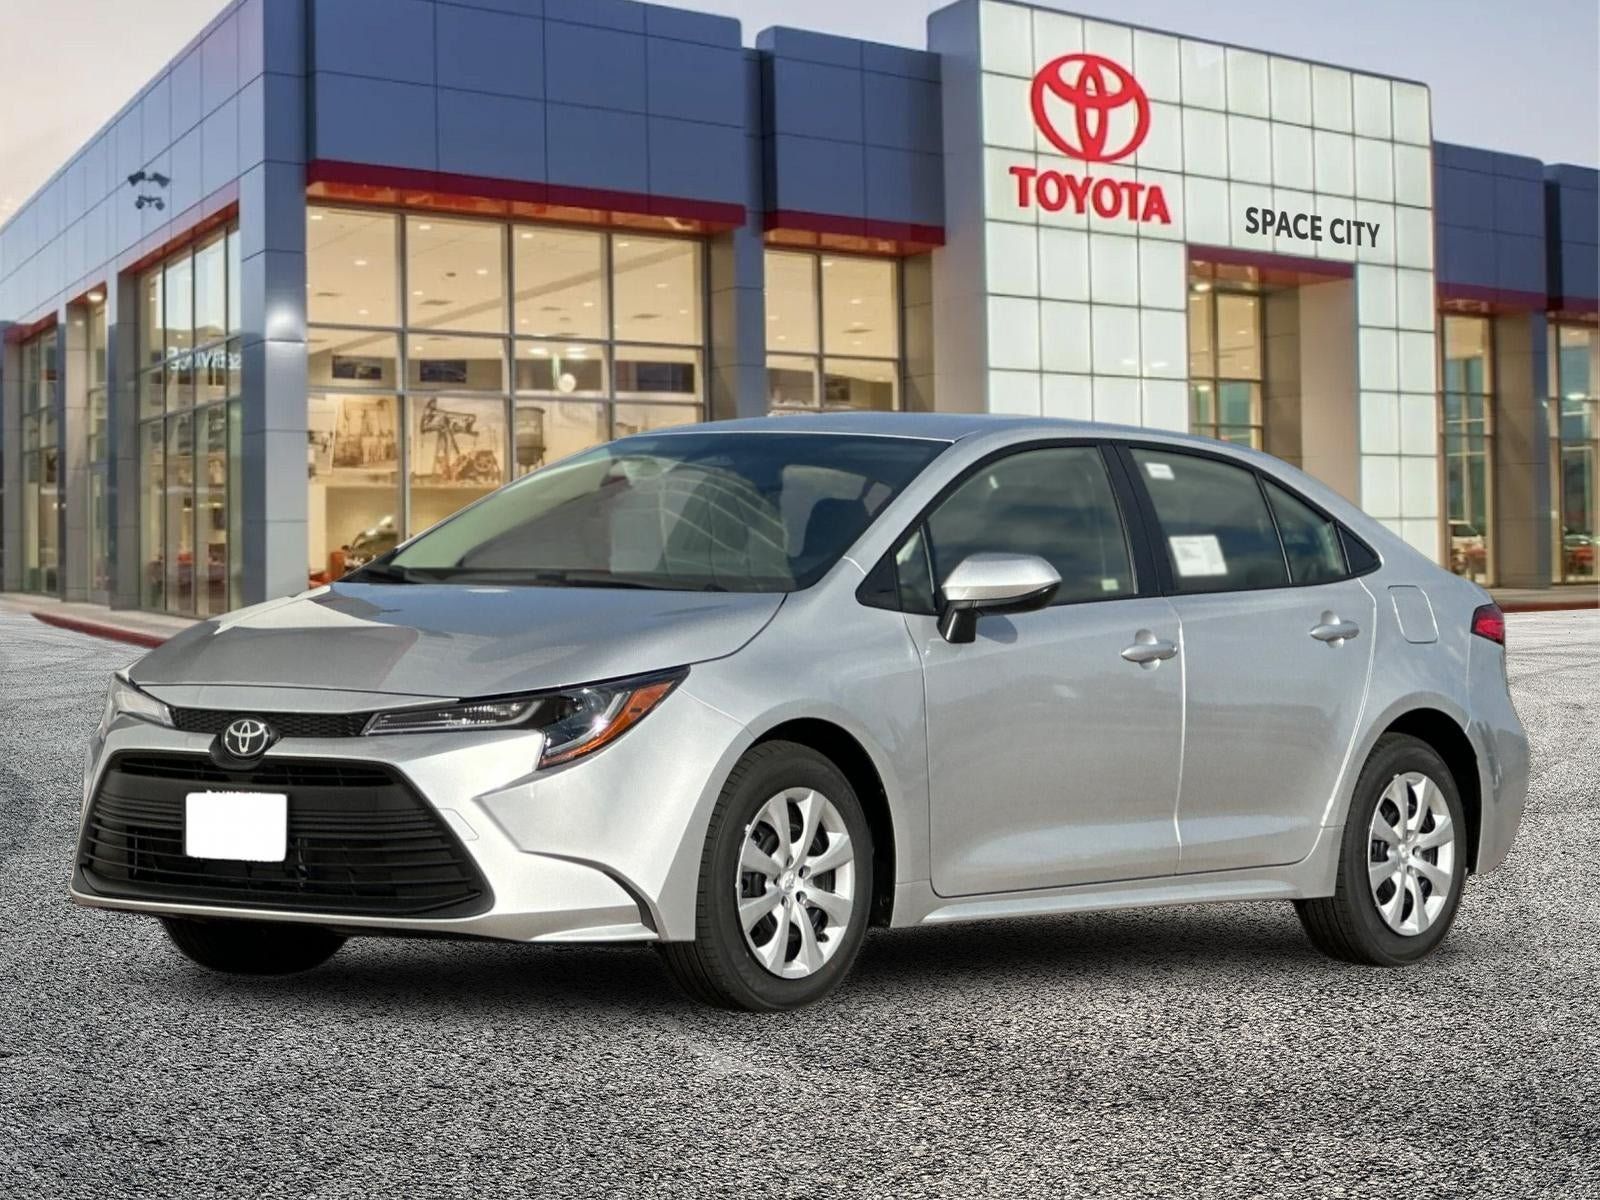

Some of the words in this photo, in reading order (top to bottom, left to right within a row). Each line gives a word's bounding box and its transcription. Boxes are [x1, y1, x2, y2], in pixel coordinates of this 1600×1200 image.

[1009, 166, 1171, 225] TOYOTA
[1245, 206, 1323, 242] SPACE
[1329, 217, 1381, 248] CITY
